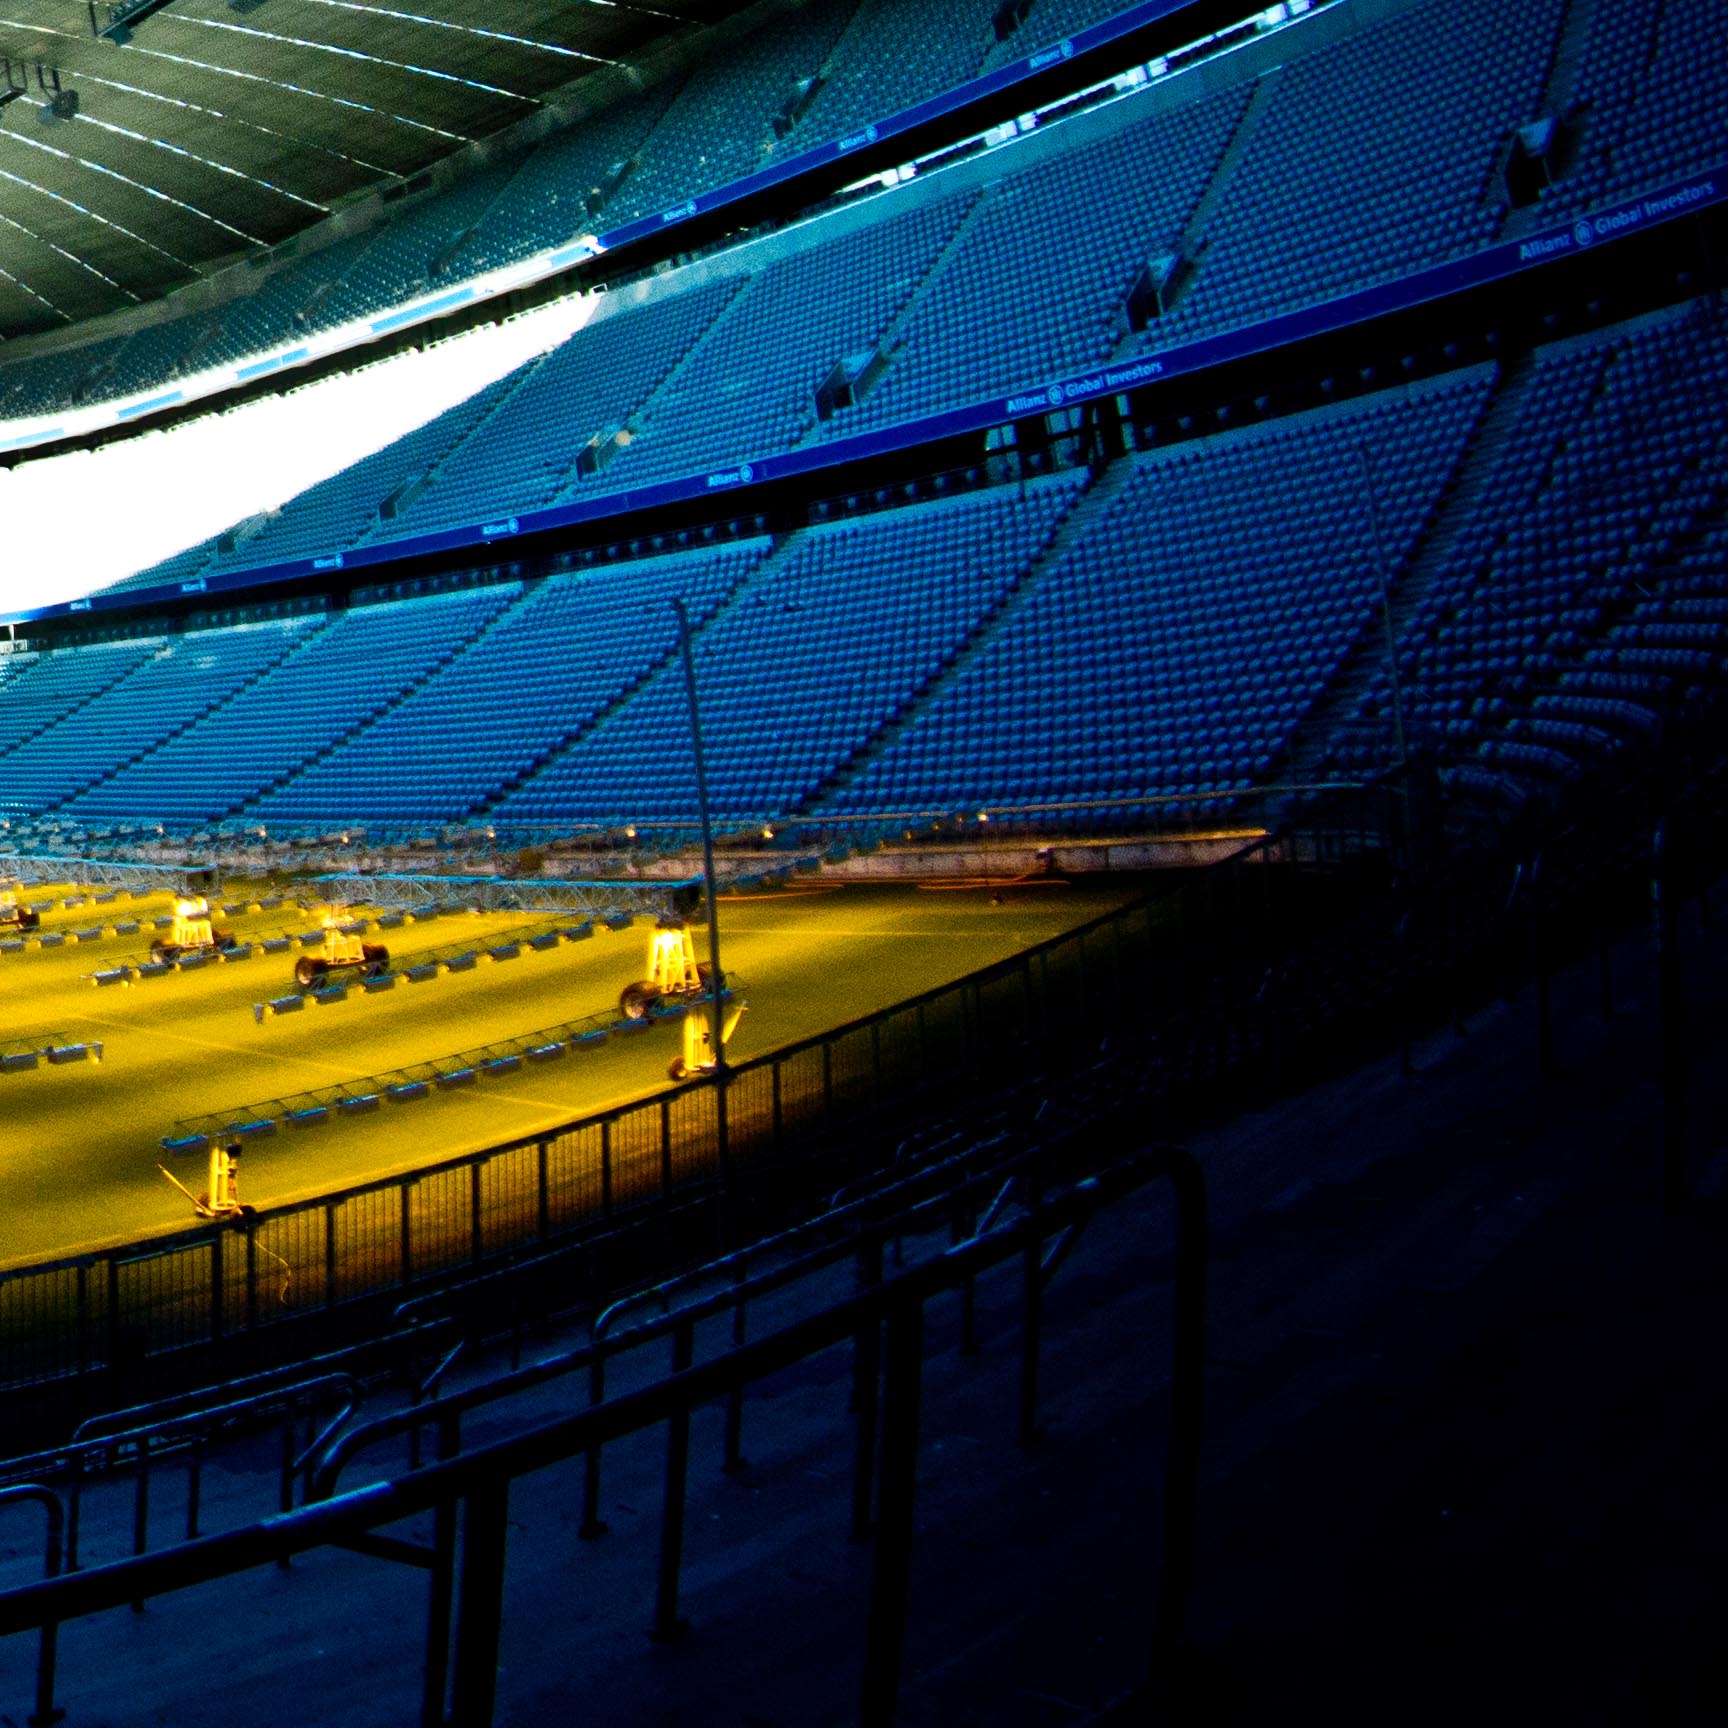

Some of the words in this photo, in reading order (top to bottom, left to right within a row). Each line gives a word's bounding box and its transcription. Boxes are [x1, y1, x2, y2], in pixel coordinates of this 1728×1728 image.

[1519, 232, 1571, 261] Allianz
[1594, 204, 1642, 234] Global
[1645, 180, 1714, 217] Investors
[1006, 395, 1047, 413] Allianz
[1066, 375, 1104, 397] Global
[1106, 361, 1163, 387] Investors
